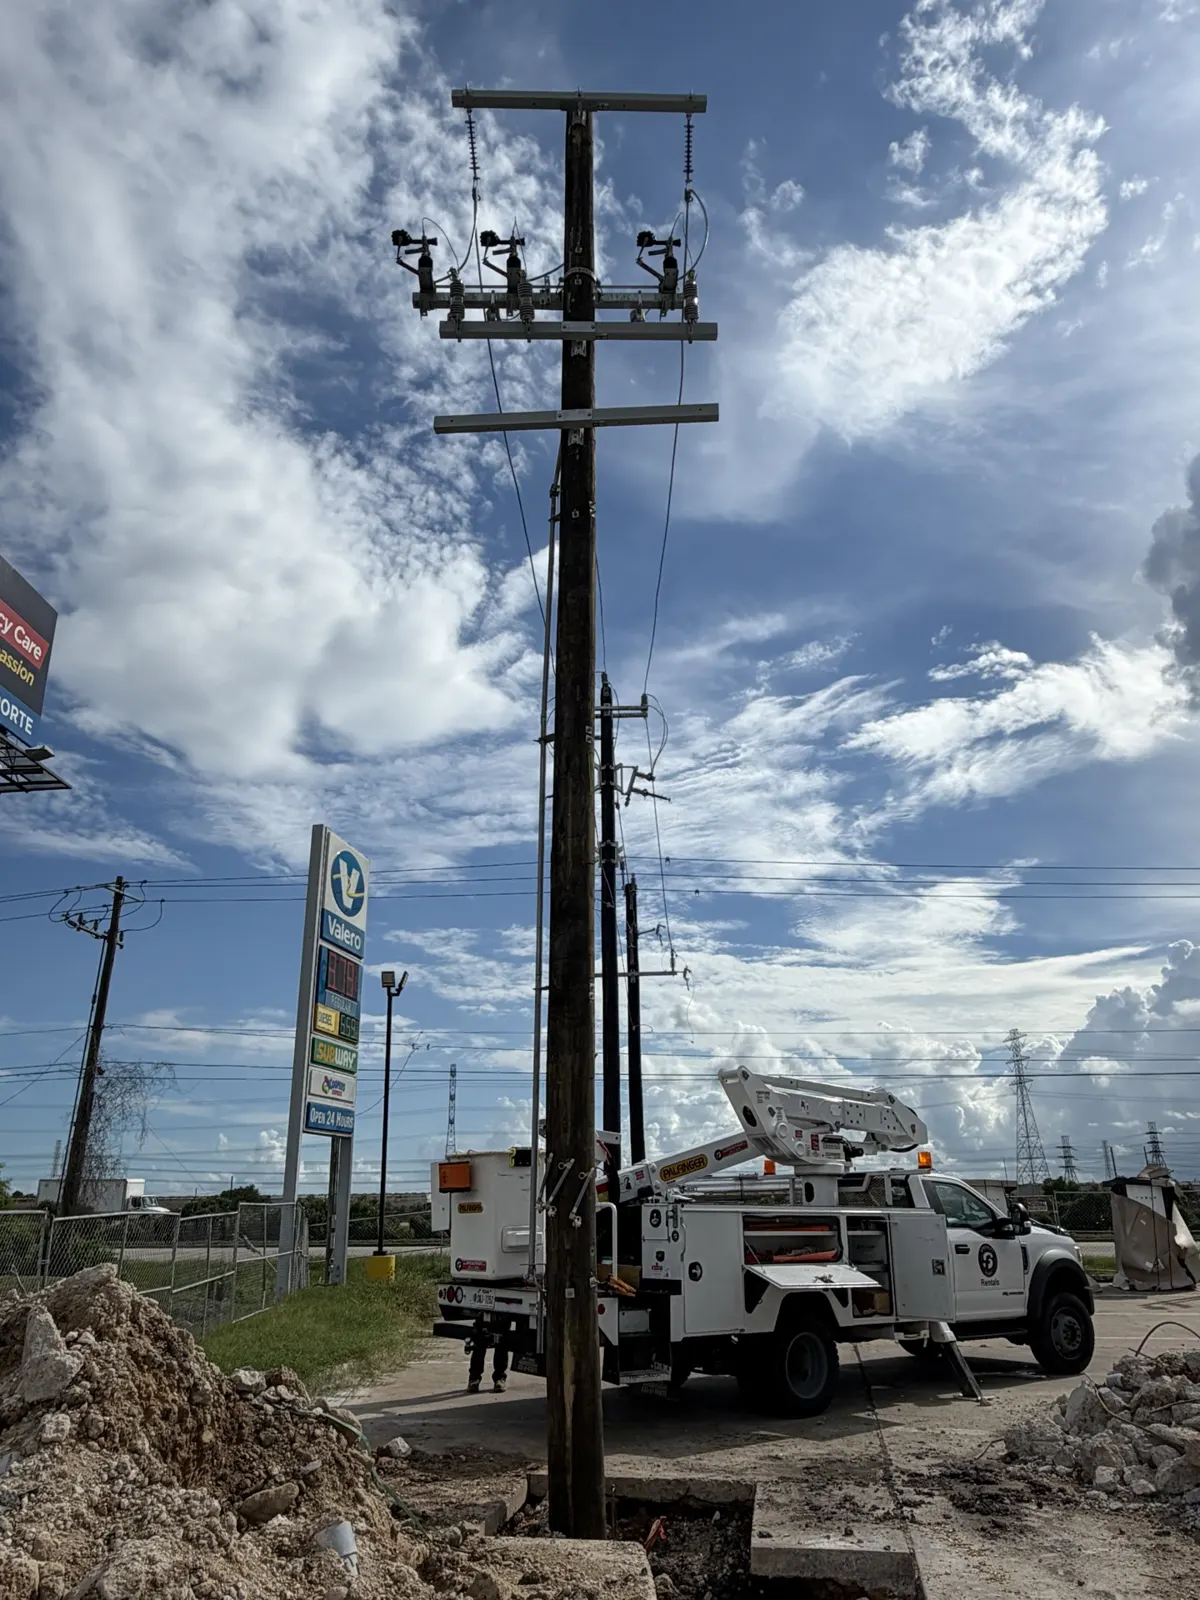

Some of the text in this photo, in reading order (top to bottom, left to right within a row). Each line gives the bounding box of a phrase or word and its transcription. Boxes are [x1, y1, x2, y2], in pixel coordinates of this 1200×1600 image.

[14, 625, 42, 661] Care
[328, 914, 361, 950] Valero
[318, 1011, 333, 1026] DIESEL
[315, 1042, 356, 1069] SUBWAY
[326, 1110, 335, 1126] 24
[662, 1157, 706, 1180] PALFINGER
[980, 1278, 1000, 1287] Rentals
